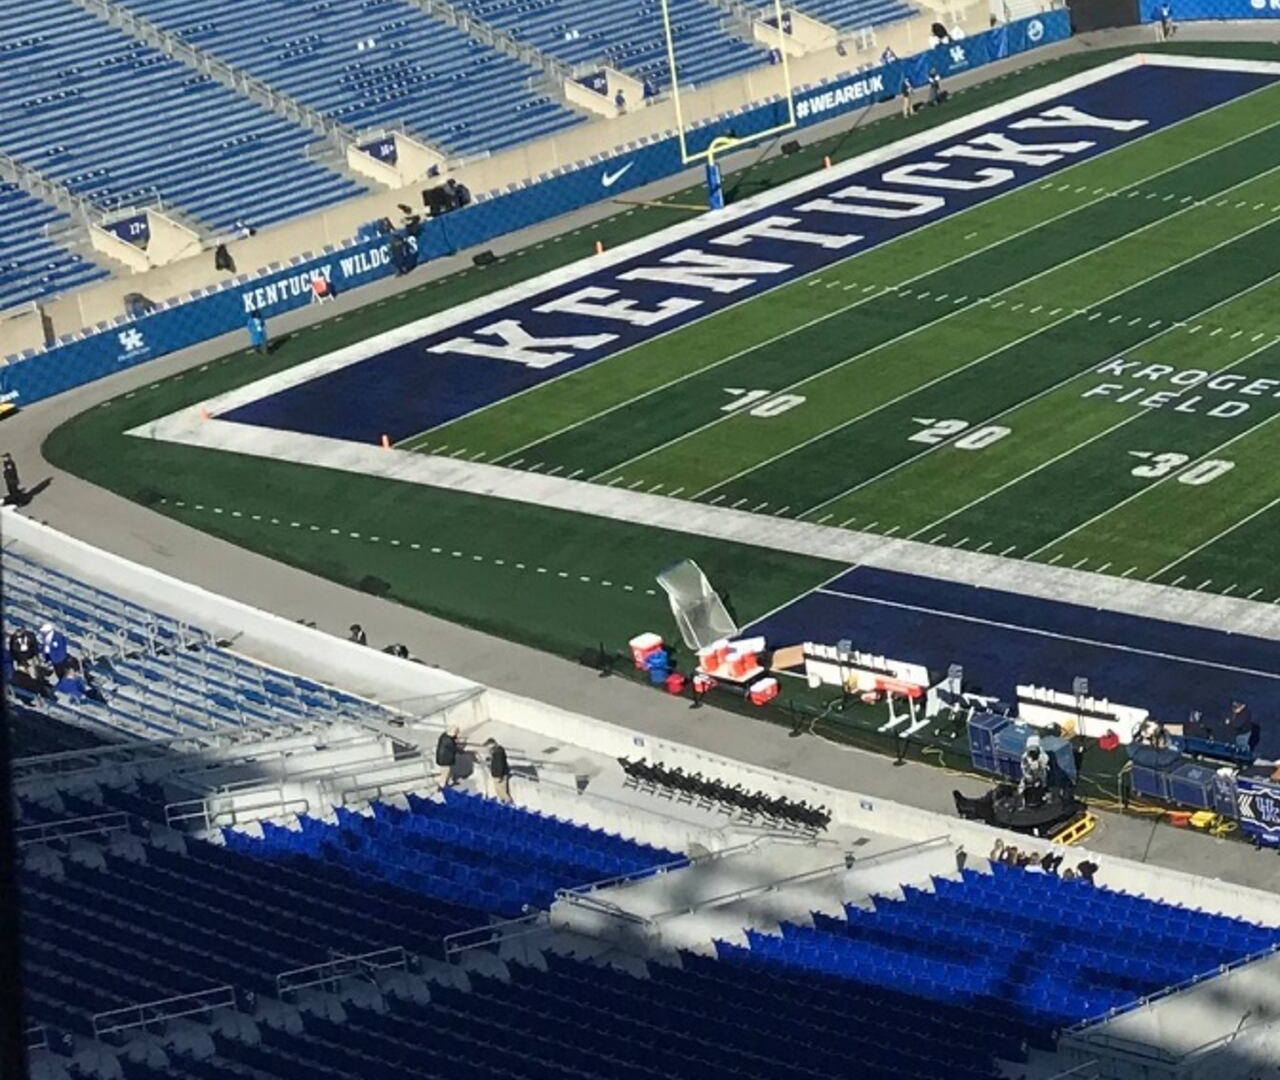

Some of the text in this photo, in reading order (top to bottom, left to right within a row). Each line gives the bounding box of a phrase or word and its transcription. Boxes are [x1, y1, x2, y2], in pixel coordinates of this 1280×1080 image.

[796, 74, 884, 119] #WEAREUK
[427, 106, 1149, 369] KENTUCKY
[340, 235, 418, 279] WILDCS
[719, 389, 807, 419] 10
[1080, 382, 1251, 418] FIELD
[908, 419, 1012, 451] 20
[1130, 452, 1236, 486] 30
